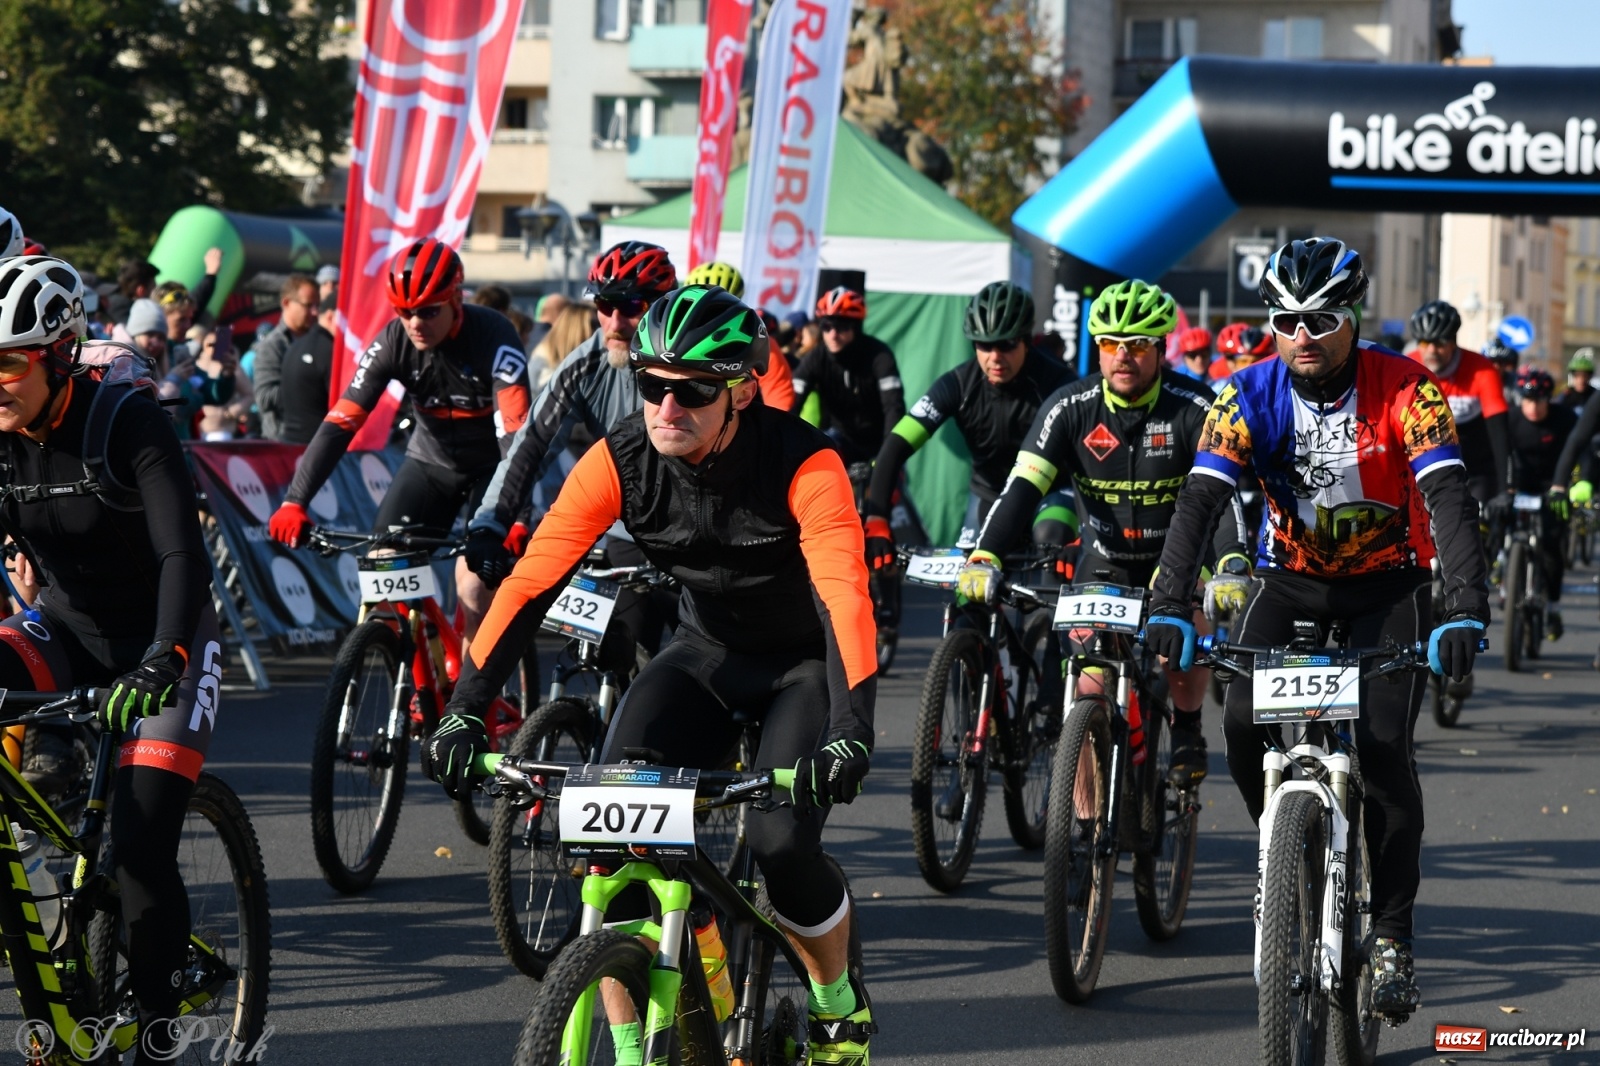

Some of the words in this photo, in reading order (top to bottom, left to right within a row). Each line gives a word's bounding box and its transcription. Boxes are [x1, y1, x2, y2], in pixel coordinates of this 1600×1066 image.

[1328, 111, 1452, 172] bike
[1466, 116, 1600, 175] ateli
[351, 341, 382, 389] KAEN
[1036, 397, 1068, 450] LEADER
[1071, 384, 1101, 405] FOX
[1073, 472, 1150, 491] LEADER
[1153, 475, 1187, 490] FO
[372, 575, 420, 594] 1945
[1072, 602, 1127, 618] 1133
[1271, 675, 1340, 698] 2155
[600, 773, 661, 782] MTBMARATON
[582, 802, 670, 834] 2077
